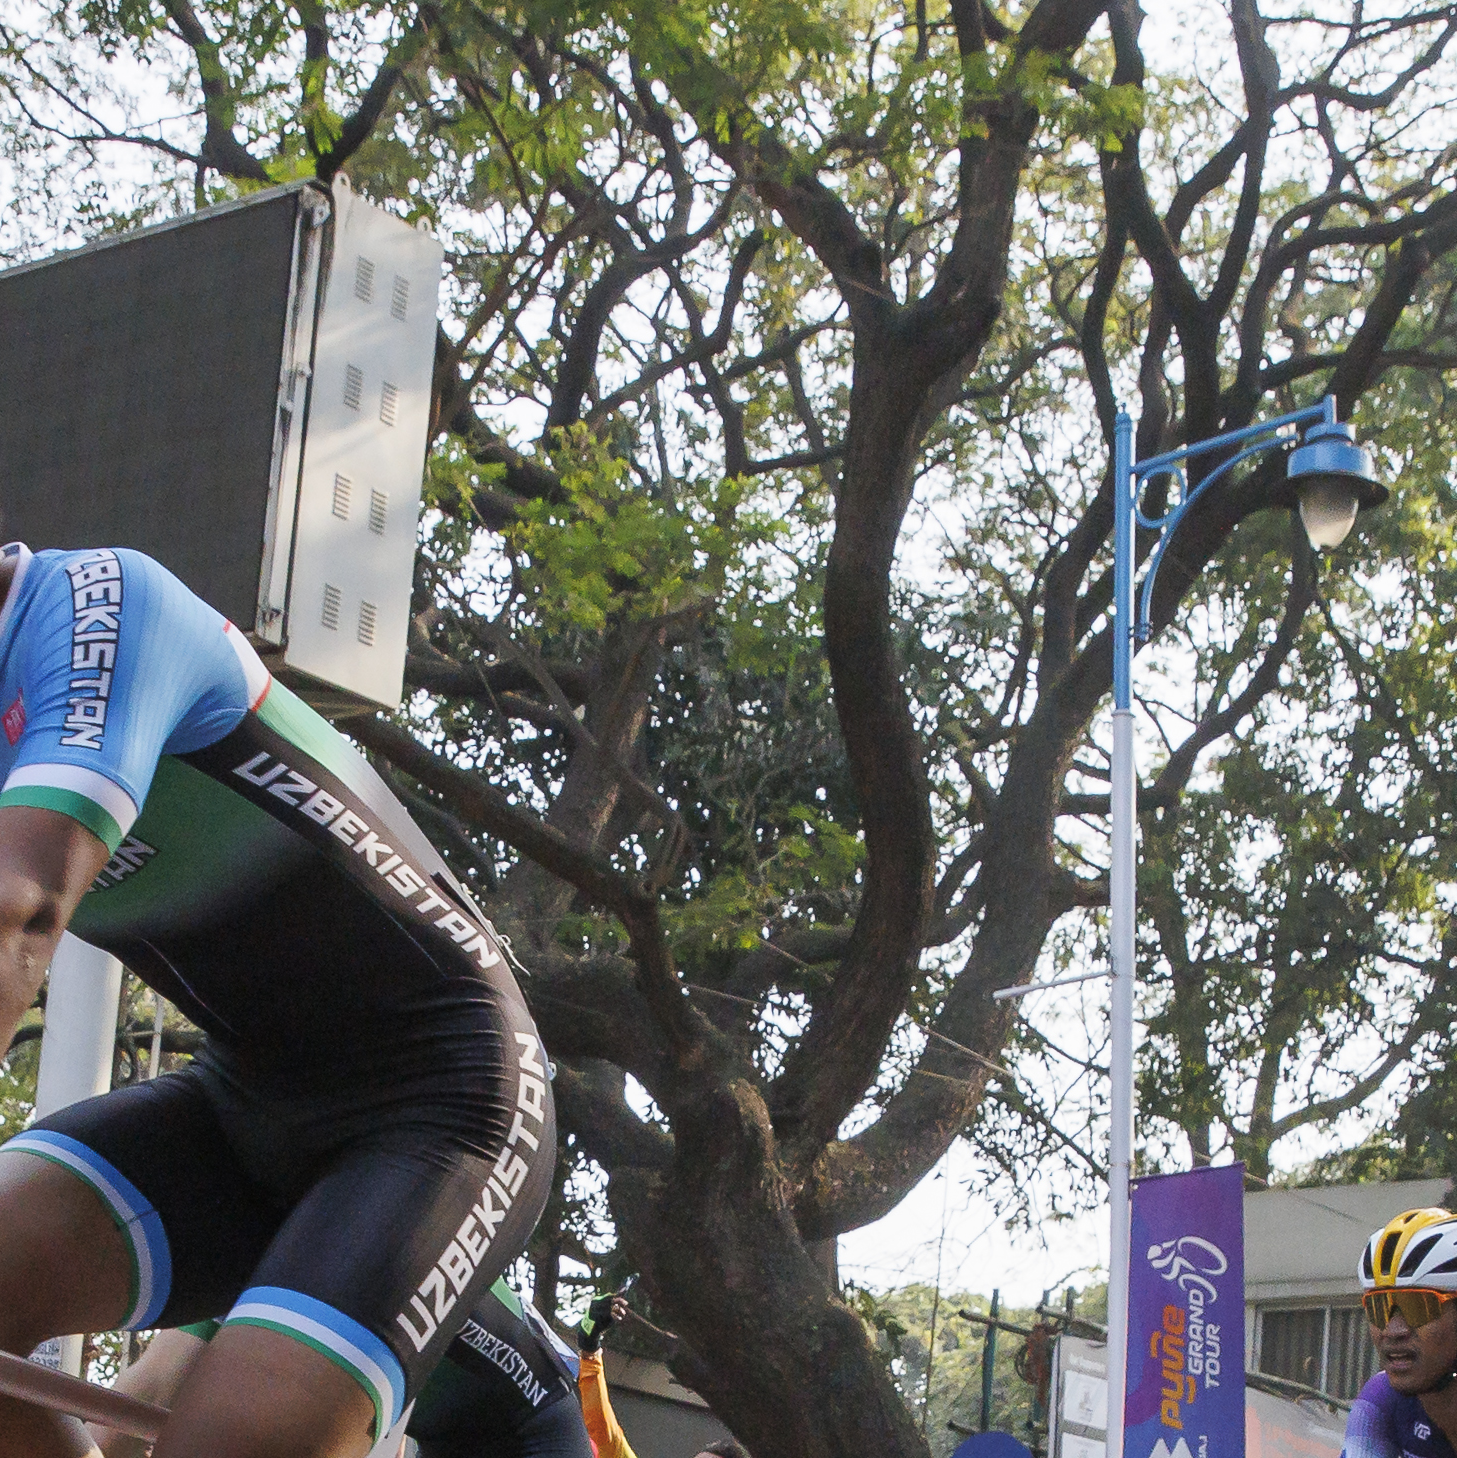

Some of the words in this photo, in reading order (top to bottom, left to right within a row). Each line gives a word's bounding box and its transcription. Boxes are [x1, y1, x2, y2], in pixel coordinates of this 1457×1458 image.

[232, 751, 501, 969] UZBEKISTAN
[396, 1031, 546, 1353] UZBEKISTAN
[1188, 1289, 1206, 1376] GRAND
[1205, 1323, 1221, 1389] TOUR
